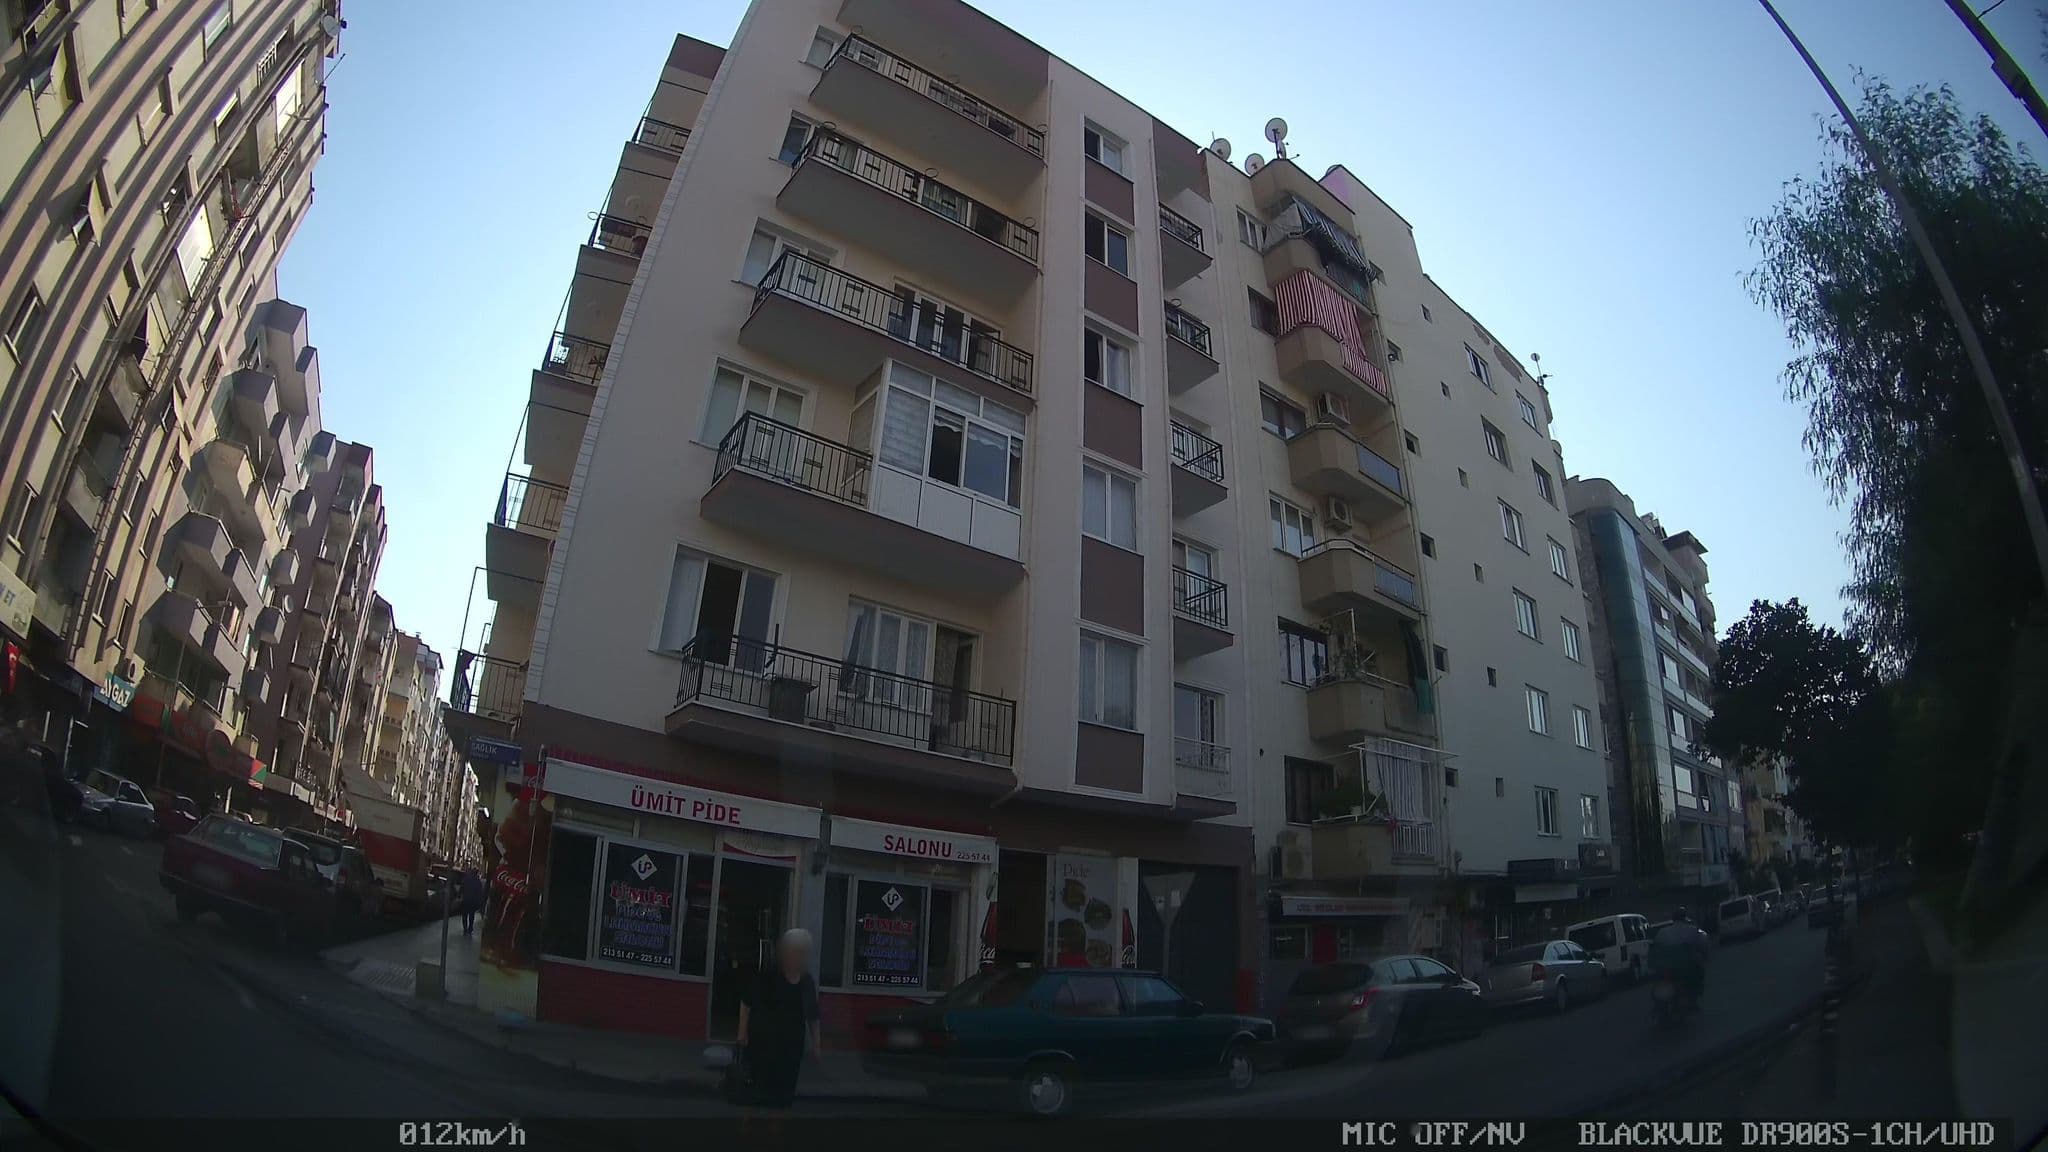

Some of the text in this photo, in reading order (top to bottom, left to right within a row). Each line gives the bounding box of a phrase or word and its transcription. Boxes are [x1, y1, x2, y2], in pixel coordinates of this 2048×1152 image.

[631, 784, 741, 825] ÜMİT PİDE
[884, 835, 952, 858] SALONU
[640, 953, 653, 963] 225
